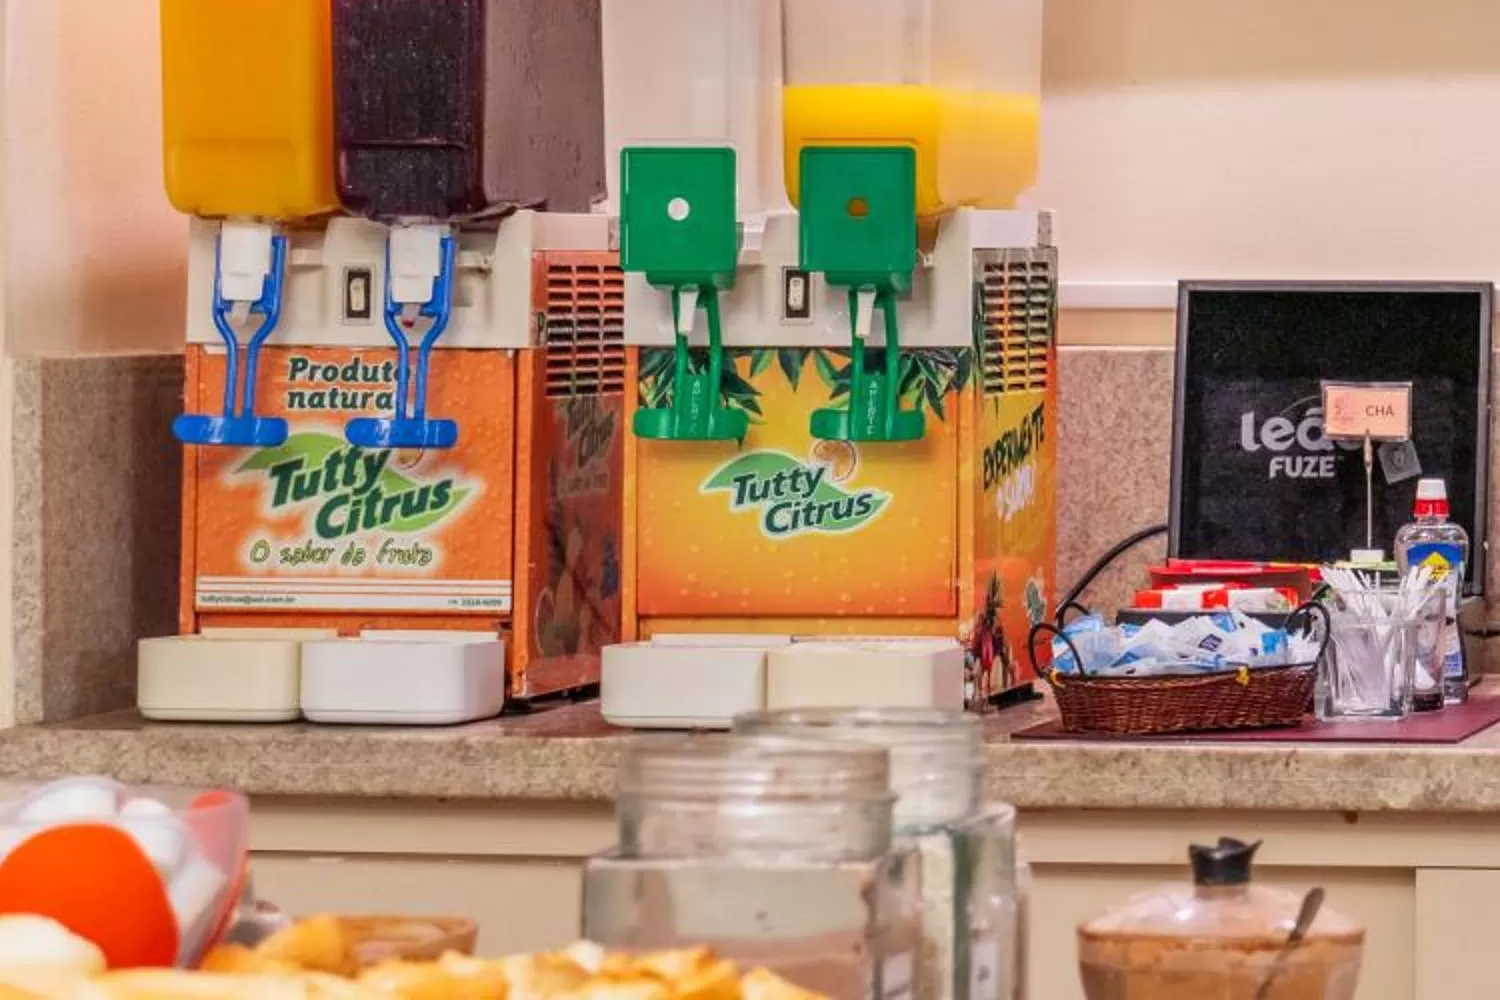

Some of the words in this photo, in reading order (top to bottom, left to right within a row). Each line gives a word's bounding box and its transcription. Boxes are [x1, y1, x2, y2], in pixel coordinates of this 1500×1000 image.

[288, 387, 394, 410] natura
[1241, 406, 1364, 452] leã
[270, 444, 390, 509] Tutty
[733, 466, 826, 508] Tutty
[1269, 455, 1336, 480] FUZE
[315, 478, 454, 540] Citrus
[765, 492, 874, 533] Citrus
[250, 539, 271, 563] O
[280, 539, 336, 567] sabor
